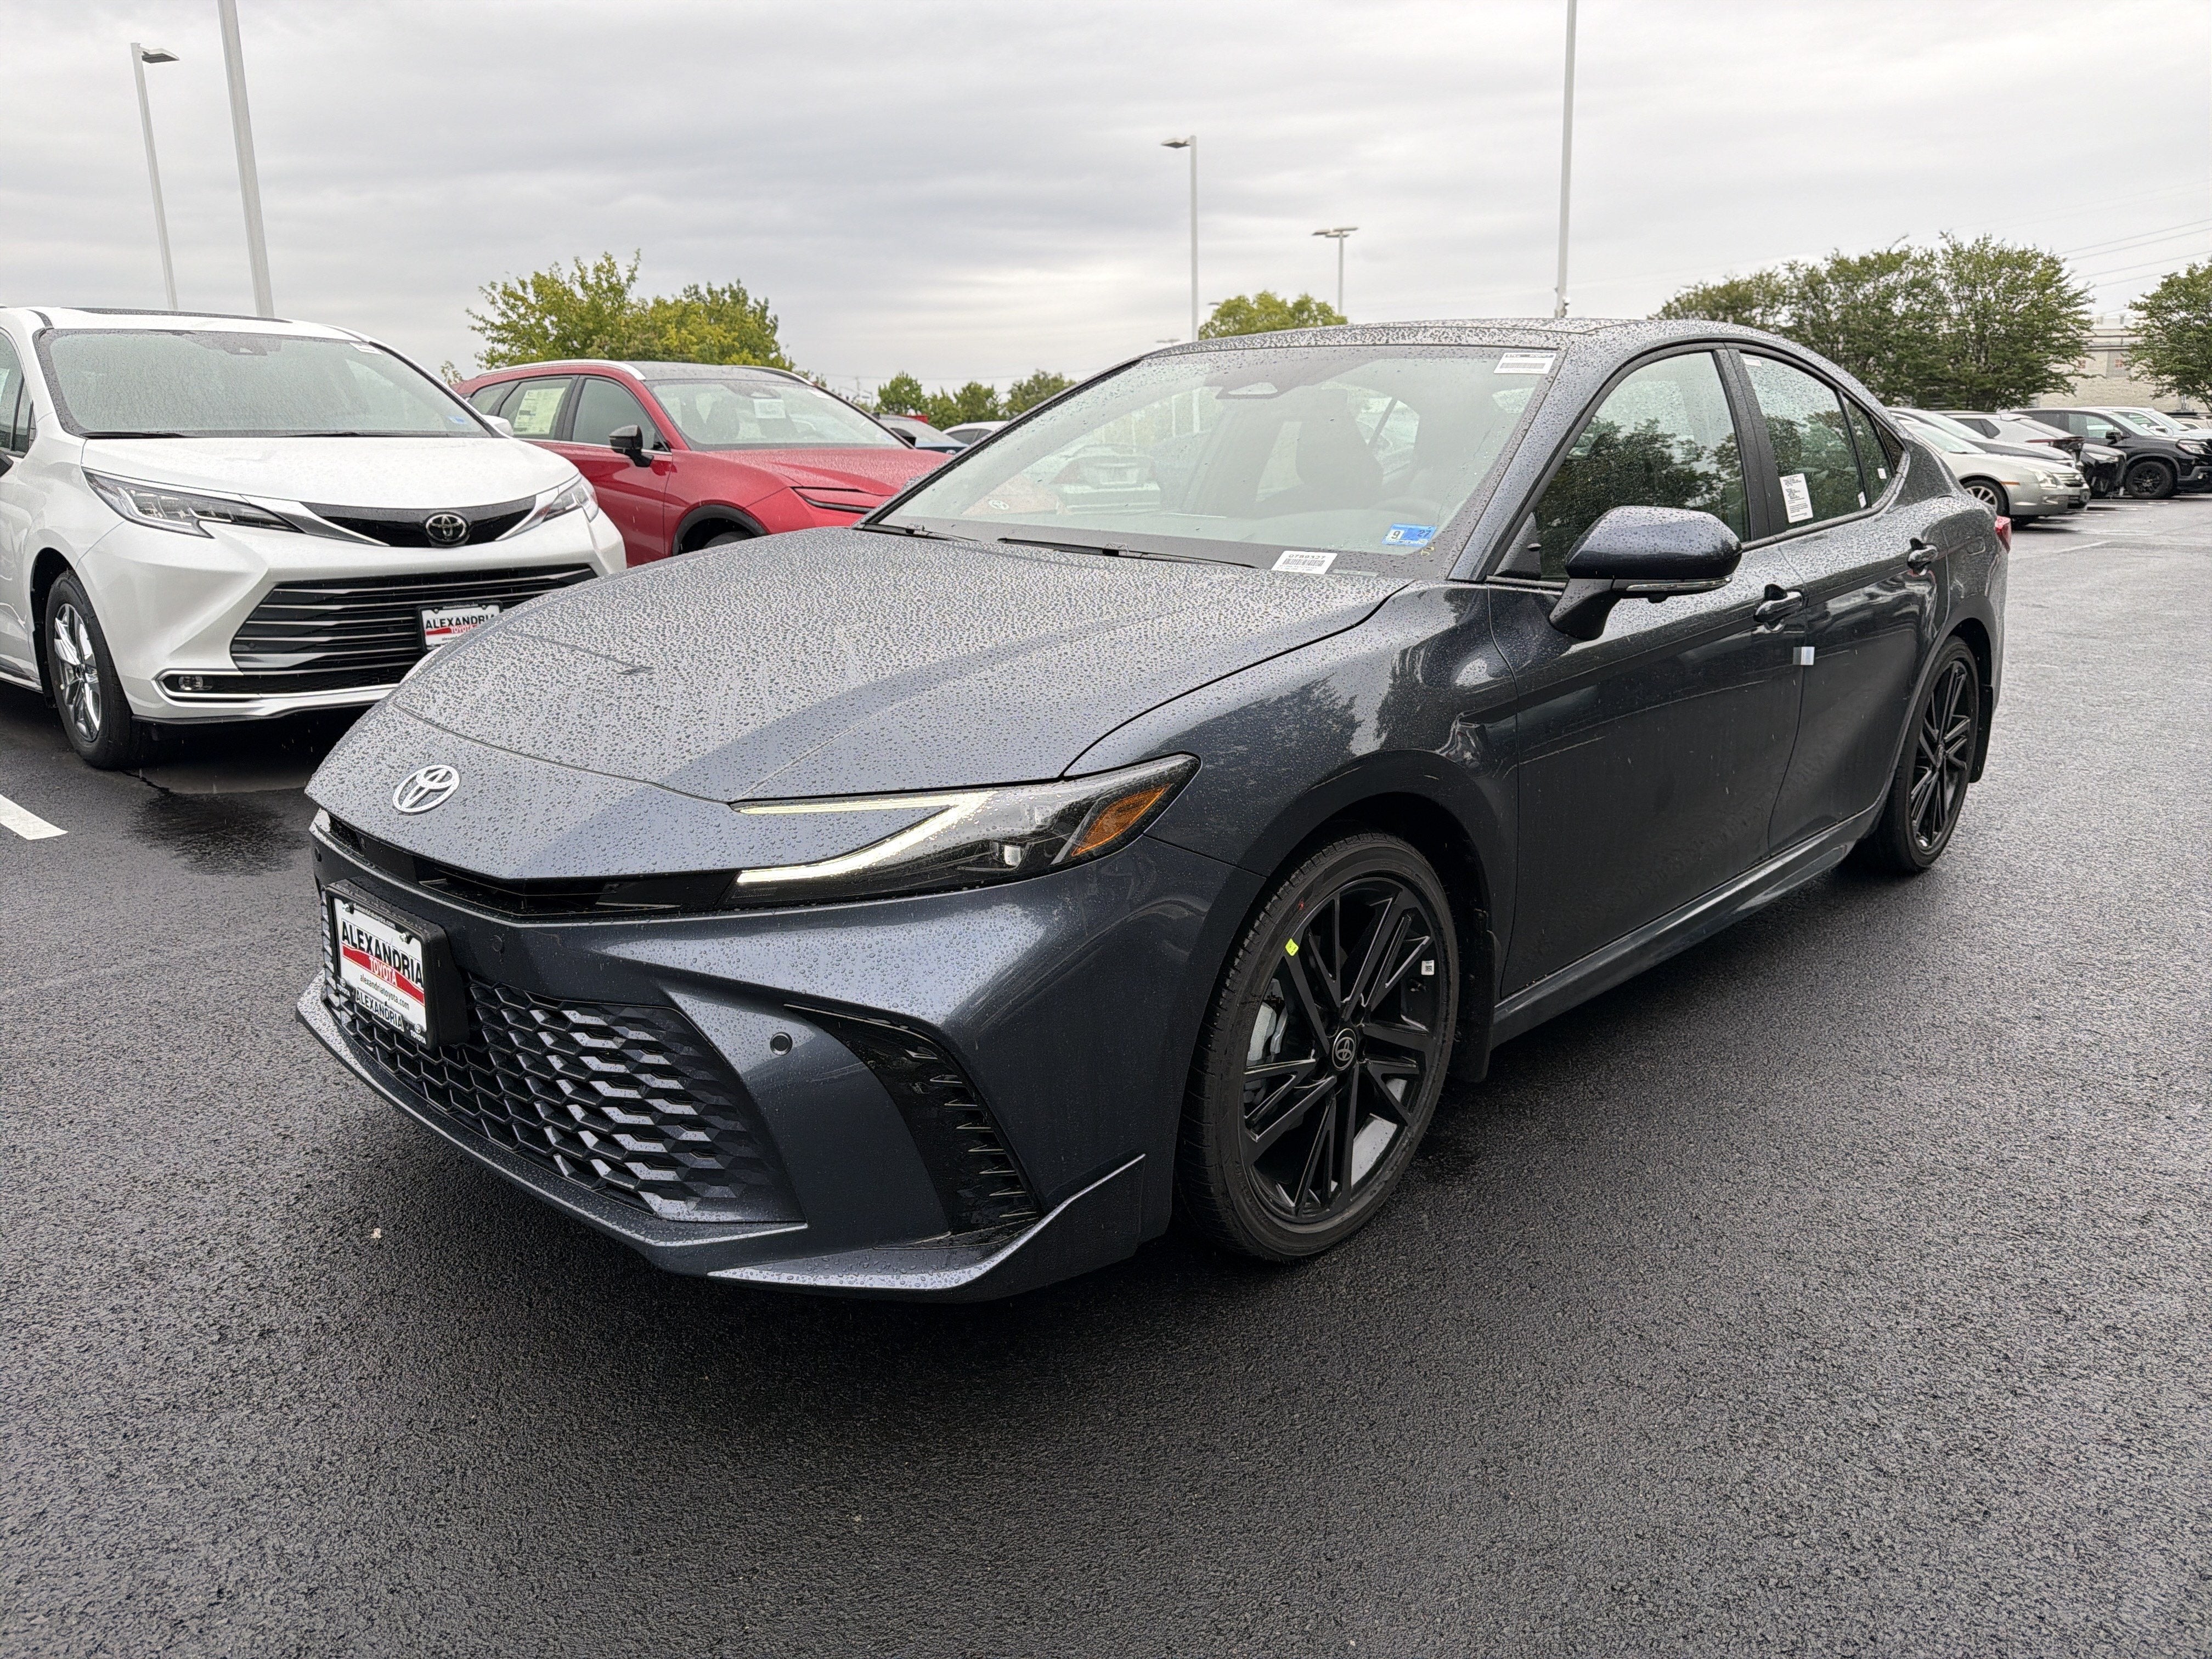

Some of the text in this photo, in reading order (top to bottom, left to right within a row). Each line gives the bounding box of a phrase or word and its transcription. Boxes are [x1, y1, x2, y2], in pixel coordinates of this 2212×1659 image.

[1391, 530, 1401, 539] 9
[342, 921, 424, 986] ALEXANDRIA
[369, 956, 398, 987] TOYOTA
[360, 973, 410, 1011] alexandriatoyota.com
[356, 989, 405, 1032] ALEXANDRIA
[410, 1030, 427, 1045] TOYOTA
